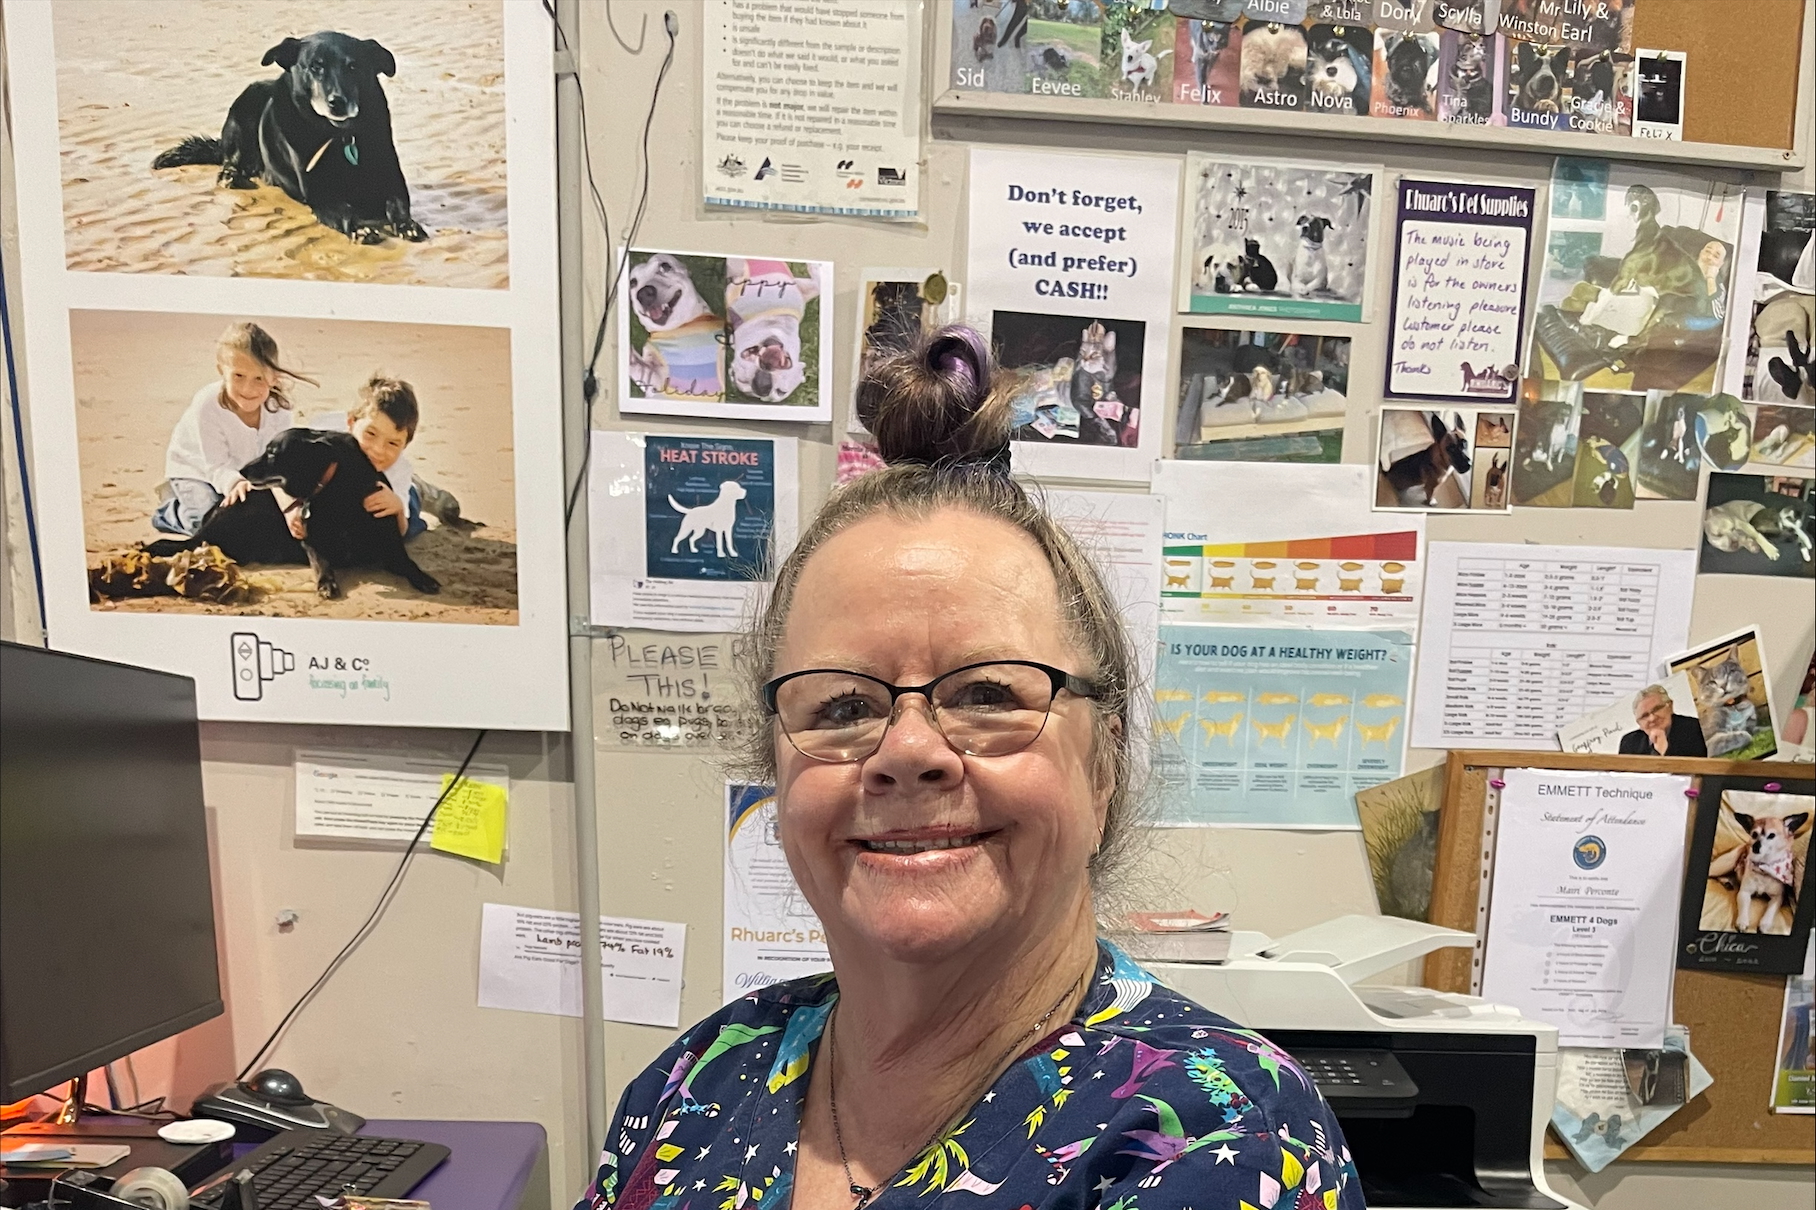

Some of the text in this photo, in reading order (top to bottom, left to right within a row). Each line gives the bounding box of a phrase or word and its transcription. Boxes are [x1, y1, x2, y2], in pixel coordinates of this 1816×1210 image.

[1337, 6, 1361, 21] Lola
[1438, 3, 1482, 25] Scylla
[1539, 0, 1561, 17] Mr
[1564, 0, 1609, 20] Lily &
[1500, 13, 1558, 39] Winston
[1561, 22, 1593, 43] Earl
[956, 68, 985, 88] Sid
[1032, 78, 1081, 96] Eevee
[1180, 84, 1221, 103] Felix
[1254, 88, 1298, 107] Astro
[1311, 91, 1352, 109] Nova
[1443, 94, 1468, 108] Tina
[1374, 102, 1420, 117] Phoenix
[1571, 96, 1612, 115] Gracie
[1511, 107, 1559, 130] Bundy
[1569, 115, 1613, 133] Cookie
[1008, 184, 1142, 214] Don't forget,
[1459, 192, 1479, 215] Pet
[1480, 193, 1529, 217] Supplies
[1022, 221, 1127, 243] we accept
[1407, 229, 1511, 258] The music being
[1009, 248, 1137, 277] (and prefer)
[1406, 252, 1505, 275] played in store
[1035, 279, 1109, 300] CASH!!
[1408, 272, 1517, 293] is for the owners
[1408, 295, 1517, 321] listening pleasure
[1457, 320, 1501, 337] please
[1401, 335, 1415, 350] do
[1420, 337, 1444, 351] not
[1394, 361, 1431, 374] Thanks
[660, 449, 759, 466] HEAT STROKE
[1187, 532, 1208, 541] Chart
[610, 634, 719, 667] PLEASE
[1171, 643, 1388, 661] IS YOUR DOG AT A HEALTHY WEIGHT?
[308, 656, 329, 671] AJ
[334, 657, 347, 671] &
[626, 673, 711, 701] THIS!
[612, 716, 648, 731] dogs
[1537, 784, 1653, 800] EMMETT Technique
[1540, 808, 1646, 834] Statement of Attendance
[1550, 915, 1618, 927] EMMETT 4 Dogs
[731, 927, 827, 943] Rhuarc's Pe
[1696, 932, 1758, 955] Chica
[631, 944, 650, 956] Fat
[652, 947, 674, 959] 19%
